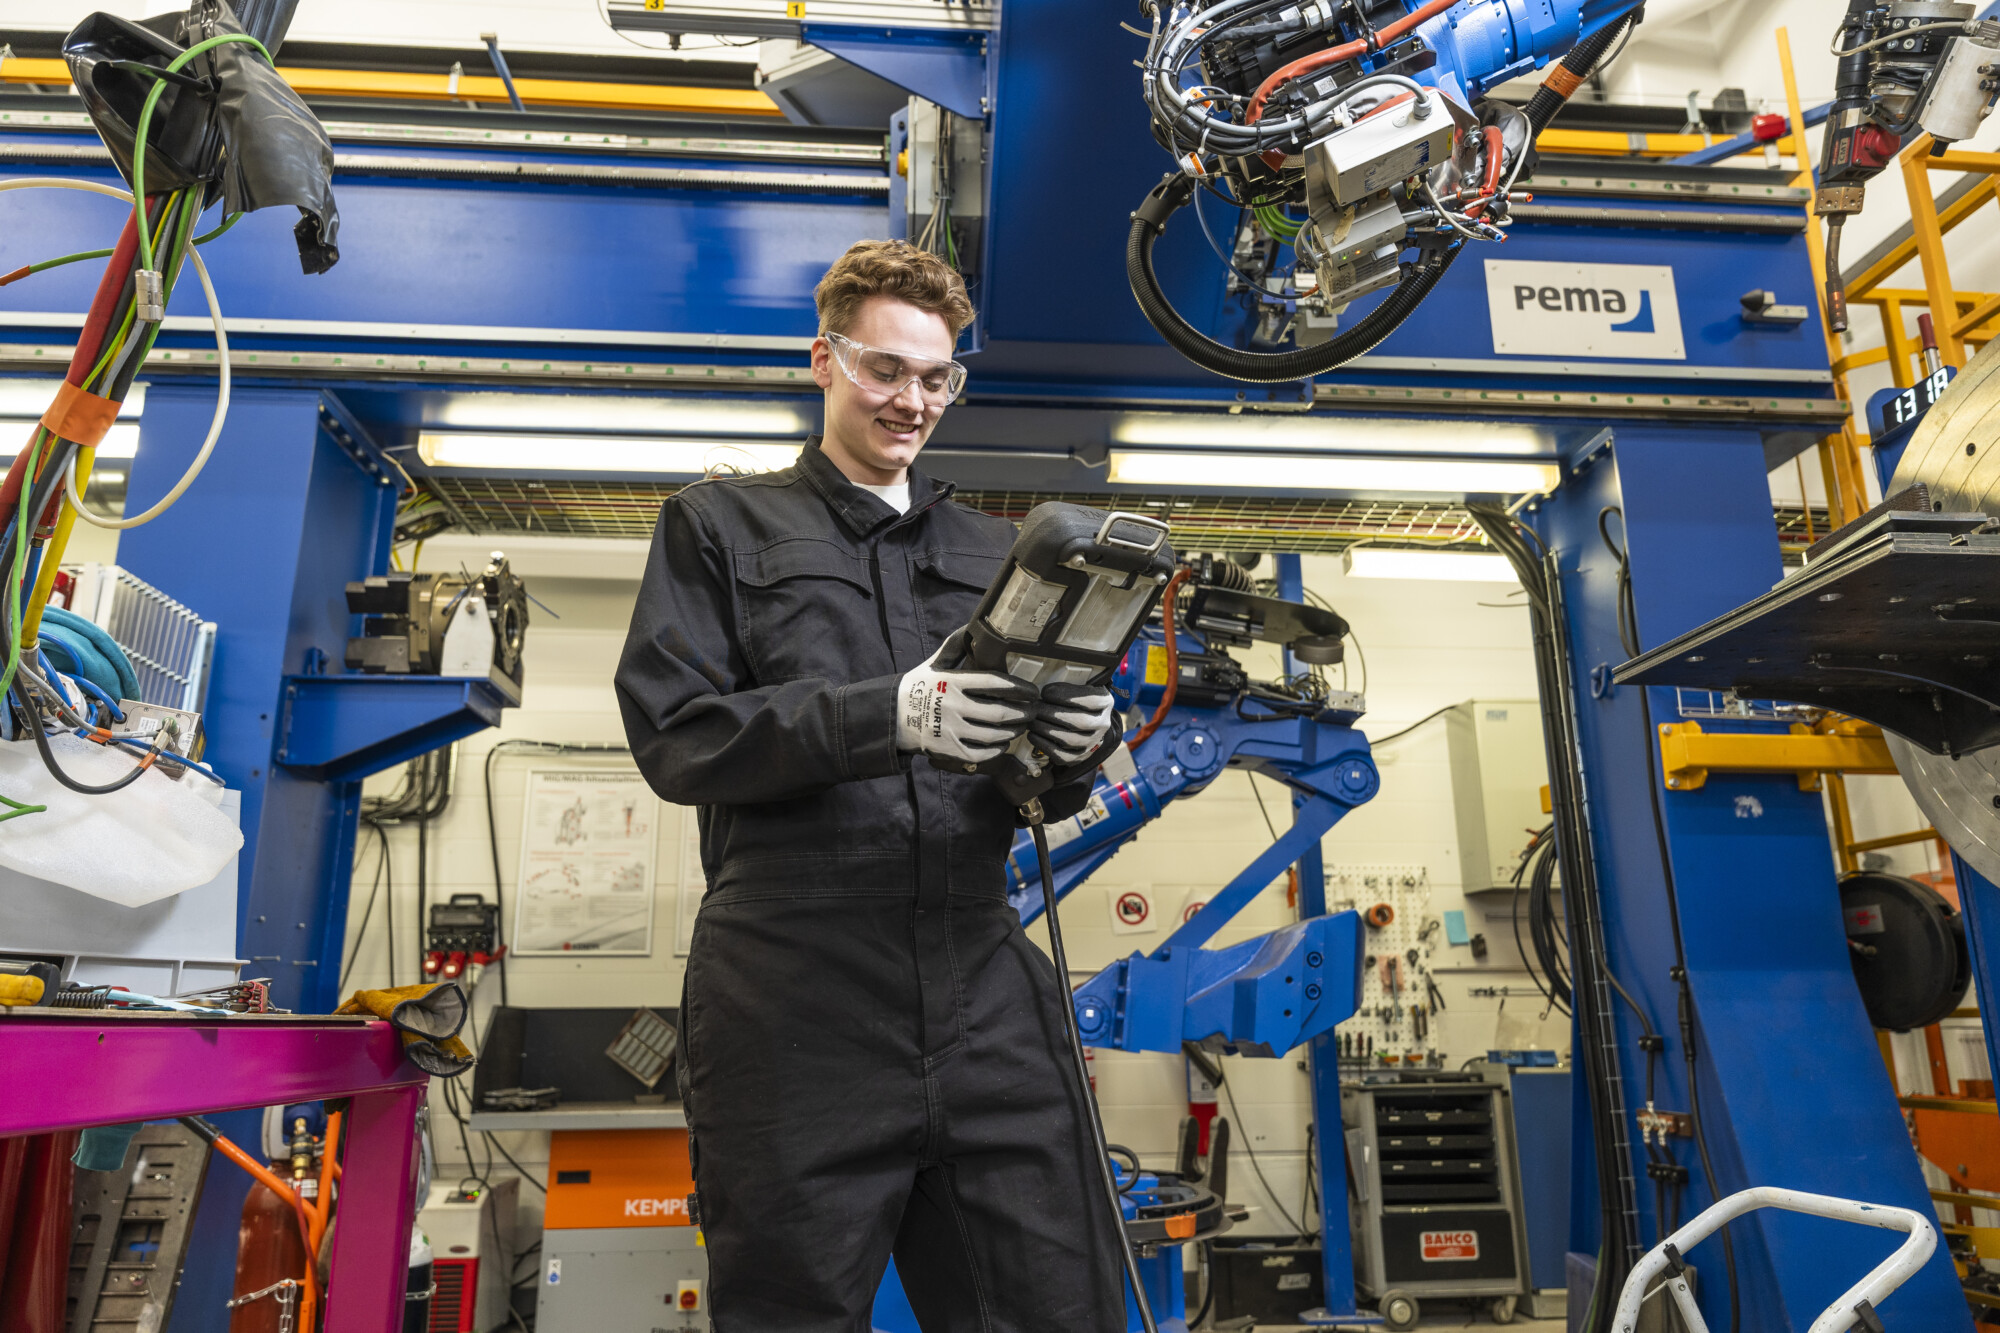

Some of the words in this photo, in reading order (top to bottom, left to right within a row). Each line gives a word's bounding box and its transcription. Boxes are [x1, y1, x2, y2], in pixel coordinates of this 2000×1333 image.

[650, 0, 659, 9] 3
[792, 4, 799, 16] 1
[1894, 387, 1917, 424] 13
[1424, 1232, 1473, 1246] BAHCO
